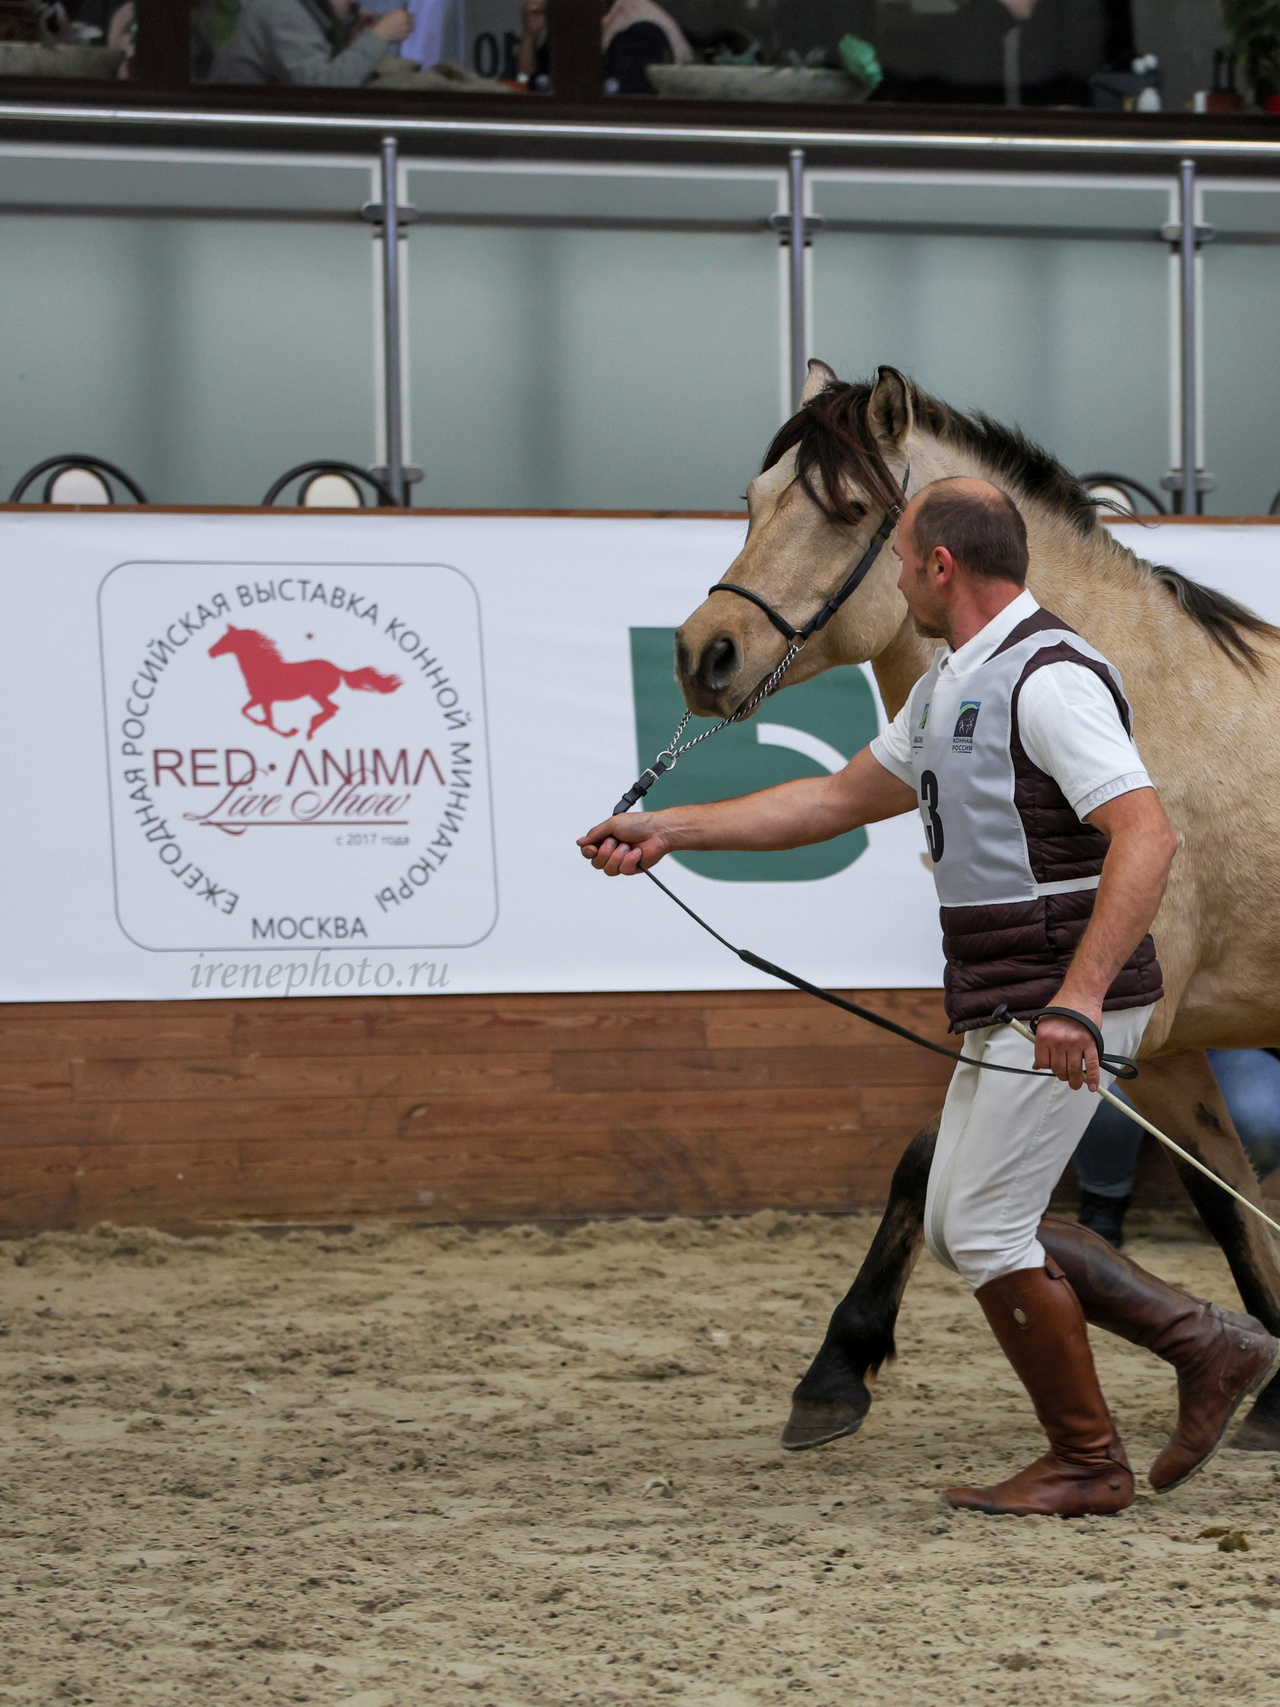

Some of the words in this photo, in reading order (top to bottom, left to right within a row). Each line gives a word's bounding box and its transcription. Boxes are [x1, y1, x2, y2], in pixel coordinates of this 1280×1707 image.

[236, 578, 381, 626] ВЫСТАВКА
[122, 593, 231, 757] РОССИЙСКАЯ
[385, 617, 473, 731] КОННОЙ
[951, 744, 974, 752] РОССИЯ
[123, 767, 240, 915] ЕЖЕГОДНАЯ
[182, 769, 282, 836] Live
[290, 769, 412, 822] Show
[346, 833, 377, 846] 2017
[381, 835, 410, 847] года
[375, 741, 472, 913] МИНИАТЮРЫ
[920, 770, 944, 863] 3
[252, 917, 368, 940] МОСКВА
